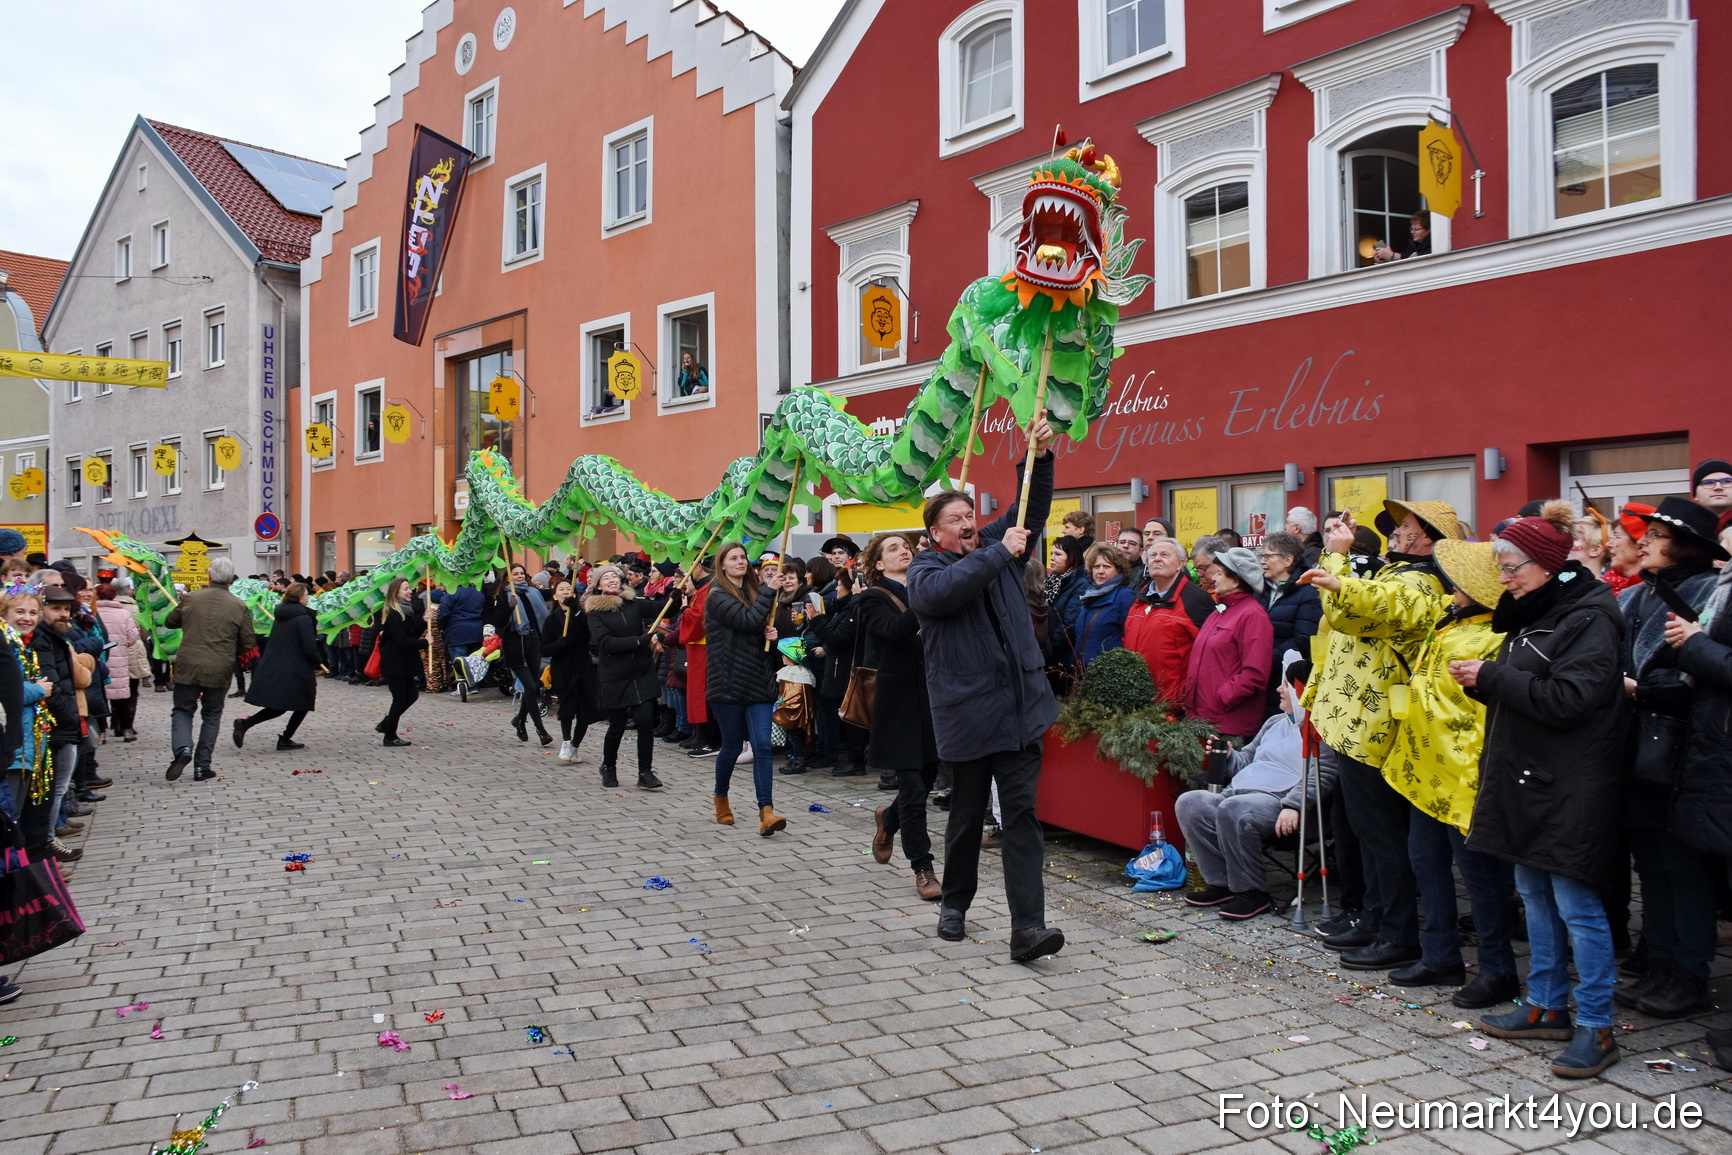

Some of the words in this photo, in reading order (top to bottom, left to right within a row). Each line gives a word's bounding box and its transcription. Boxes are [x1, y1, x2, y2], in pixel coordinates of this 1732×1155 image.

[263, 326, 275, 400] UHREN
[1096, 403, 1205, 474] Genuss
[1223, 350, 1385, 437] Erlebnis
[1101, 370, 1170, 417] rlebnis
[262, 411, 275, 513] SCHMUCK
[96, 511, 137, 536] OPTIK
[138, 505, 181, 535] OEXL
[172, 575, 195, 583] olping
